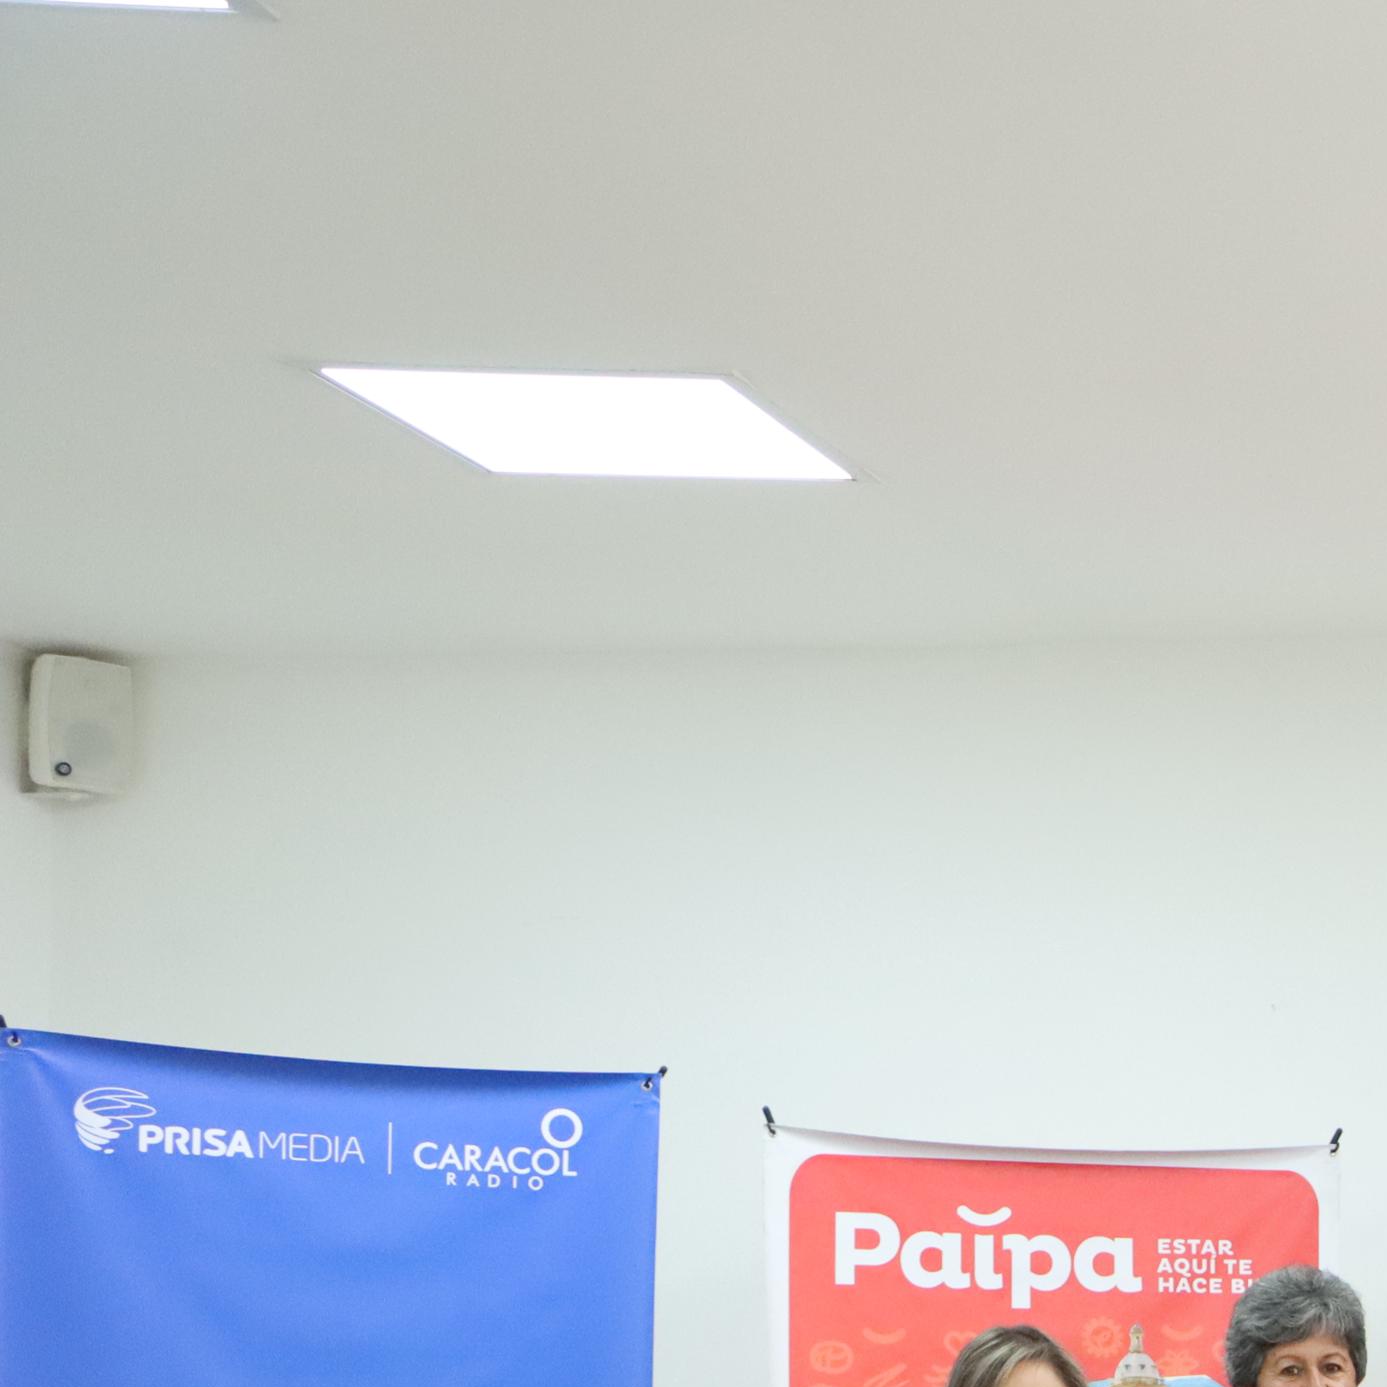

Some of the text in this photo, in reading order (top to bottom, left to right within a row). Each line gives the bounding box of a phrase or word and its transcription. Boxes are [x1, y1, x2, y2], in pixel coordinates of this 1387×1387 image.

[138, 1124, 366, 1164] PRISA MEDIA
[412, 1140, 578, 1177] CARACOL
[446, 1171, 544, 1191] RADIO
[1157, 1238, 1234, 1255] ESTAR
[1157, 1256, 1253, 1276] AQUÍ TE
[1158, 1276, 1223, 1294] HACE
